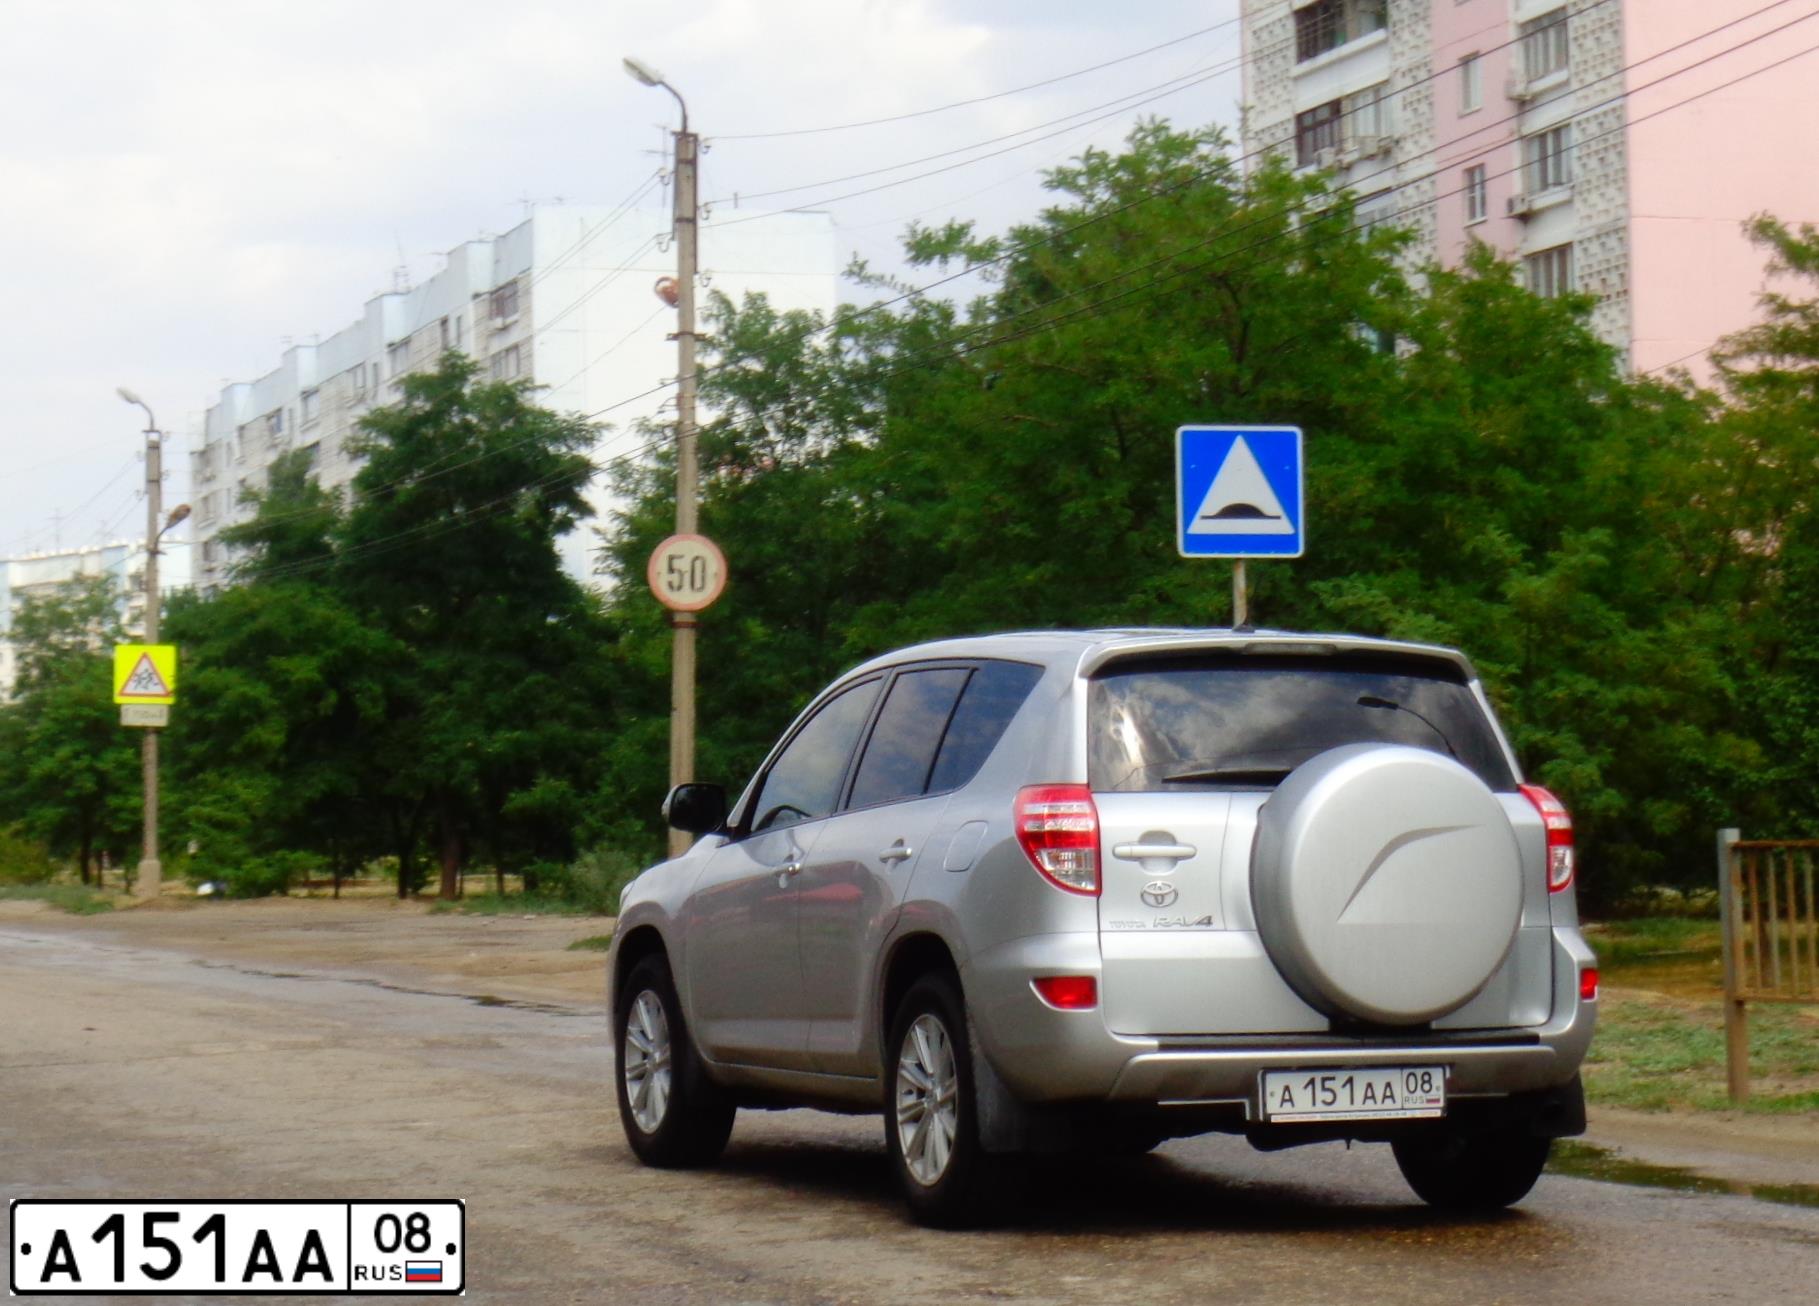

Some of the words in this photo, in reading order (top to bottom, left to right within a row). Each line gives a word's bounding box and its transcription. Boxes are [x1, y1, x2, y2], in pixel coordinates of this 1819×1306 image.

[667, 553, 706, 592] 50
[1153, 915, 1213, 928] RAV4
[1405, 1071, 1433, 1094] 08
[1404, 1096, 1424, 1105] RUS
